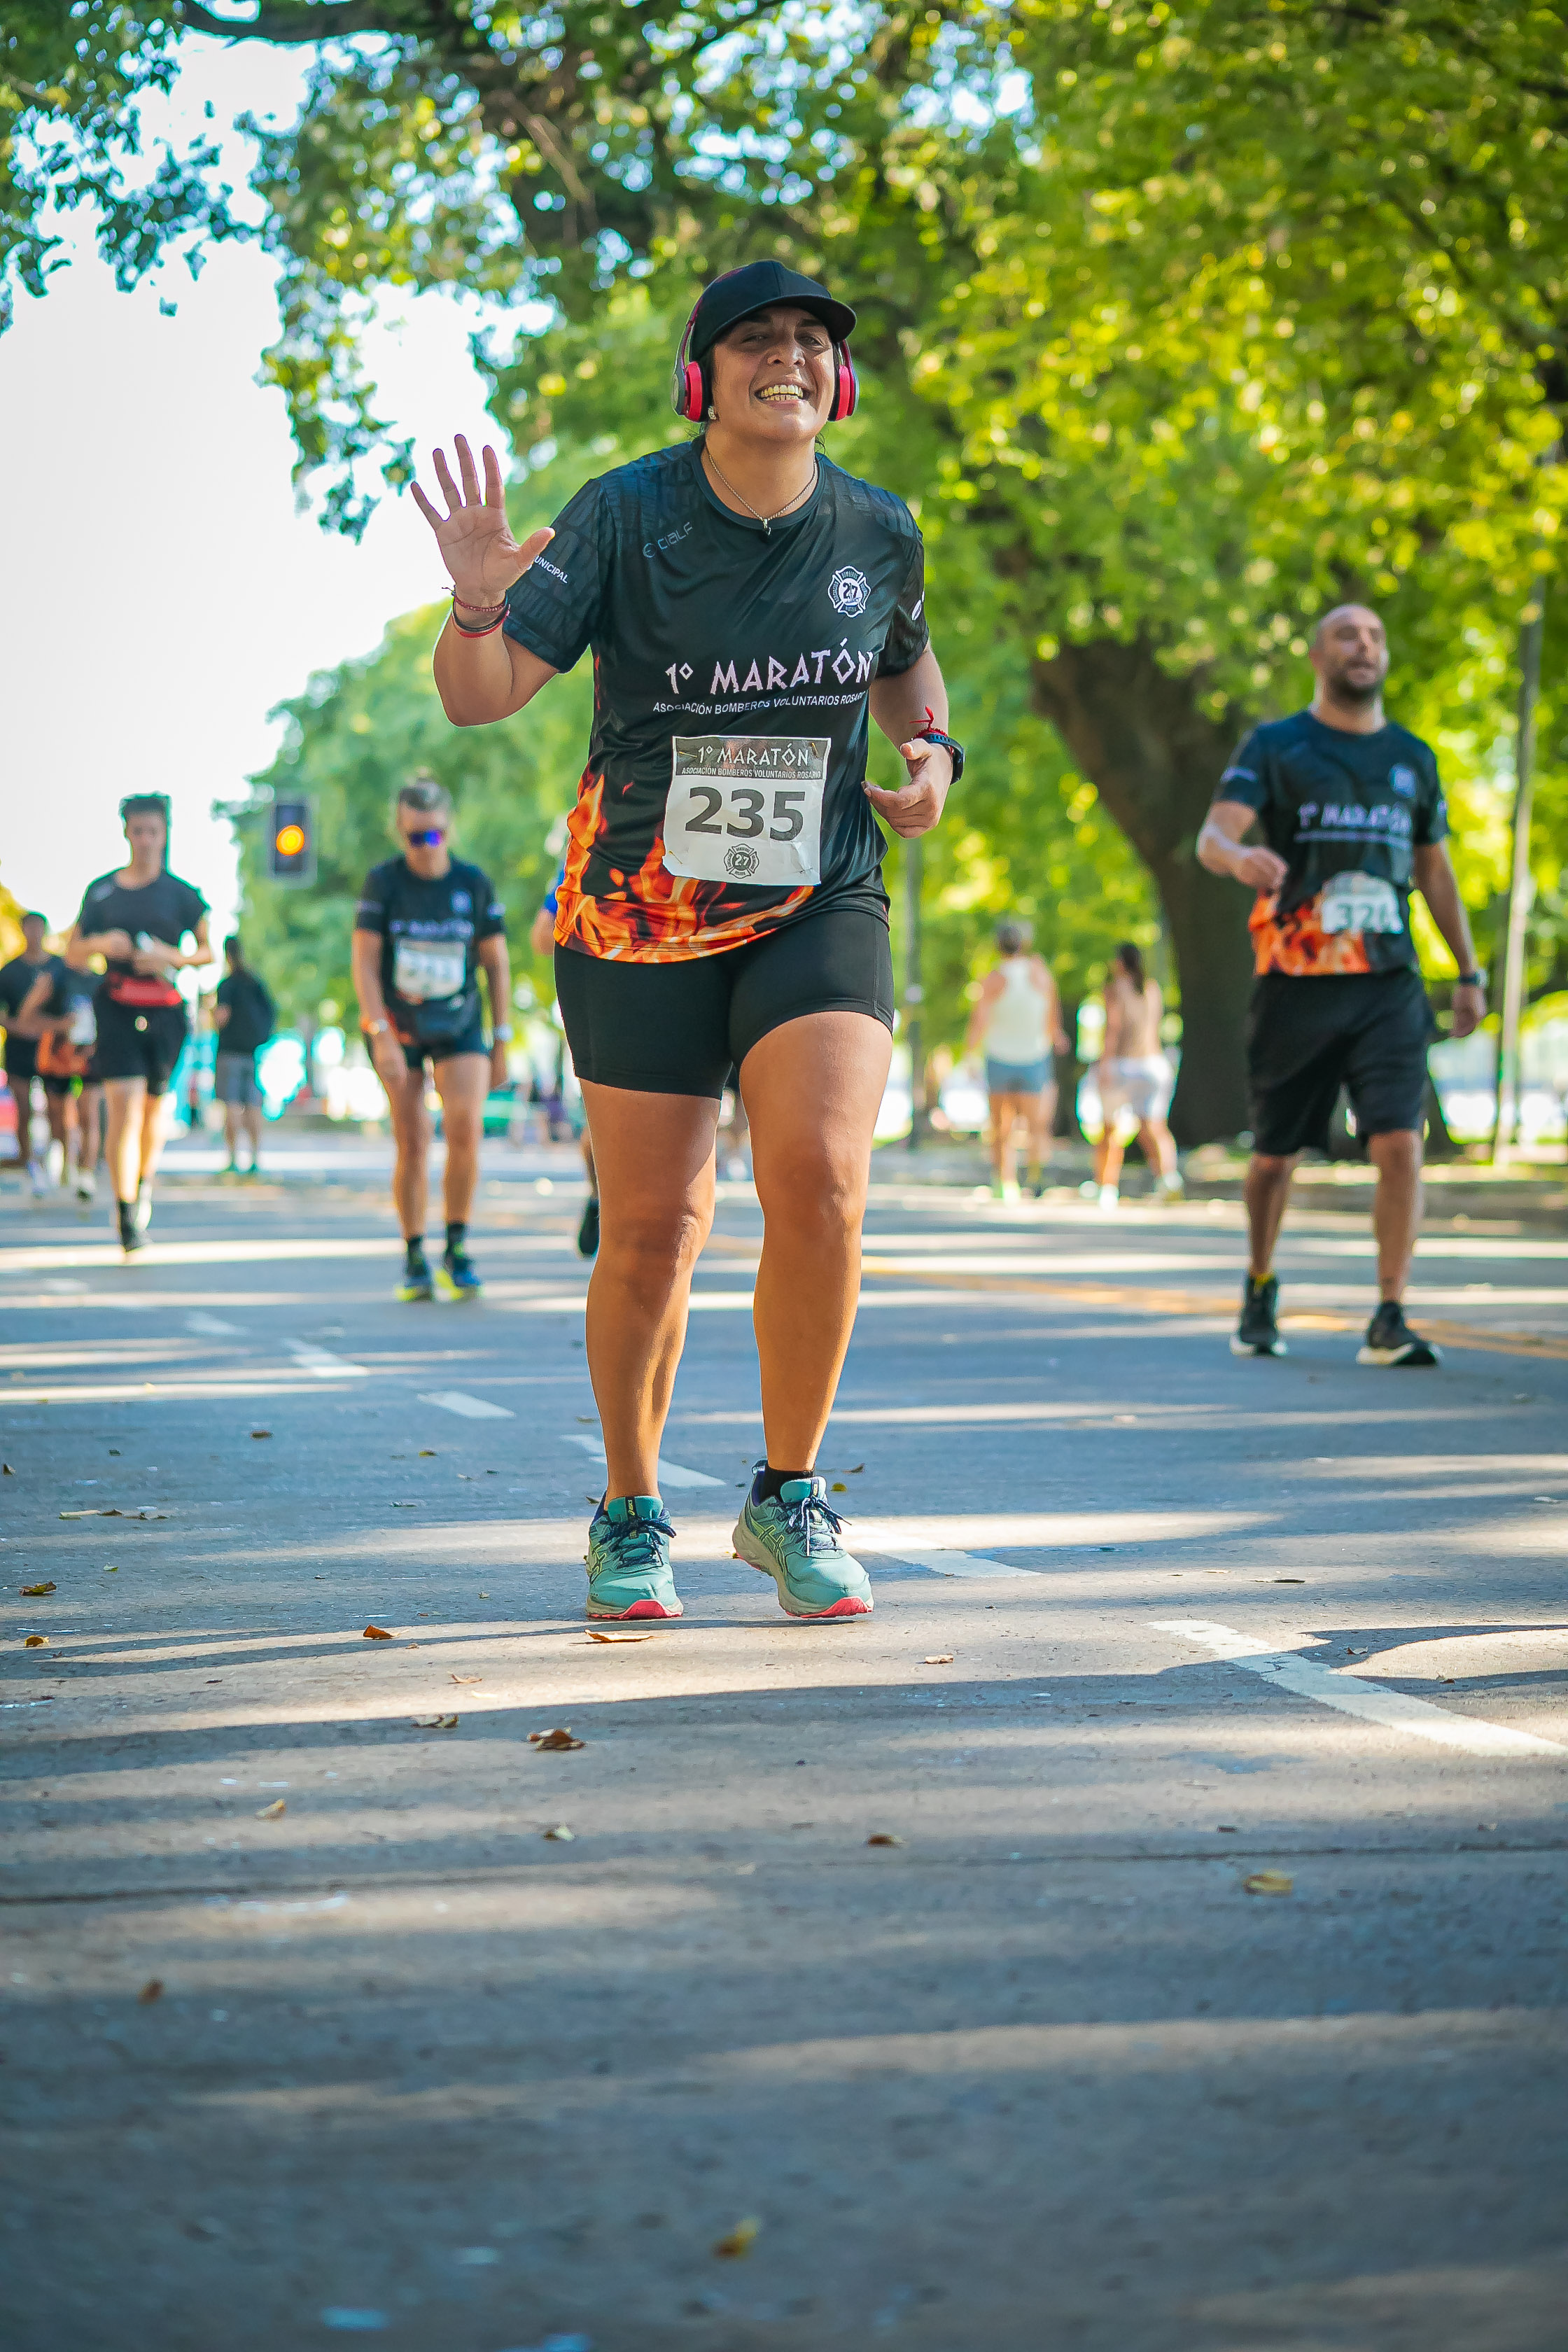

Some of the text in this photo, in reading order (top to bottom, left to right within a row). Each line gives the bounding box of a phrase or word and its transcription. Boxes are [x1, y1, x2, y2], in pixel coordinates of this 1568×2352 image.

[533, 554, 568, 584] UNICIPAL
[842, 582, 858, 599] 27
[710, 637, 873, 695] MARATÓN
[653, 701, 713, 715] ASOCIACIÓN
[715, 699, 771, 715] BOMBEROS
[773, 695, 840, 708] VOLUNTARIOS
[717, 743, 809, 767] MARATÓN
[681, 766, 822, 779] ASOCIACIÓN BOMBEROS VOLUNTARIOS ROSARIO
[685, 786, 806, 841] 235
[734, 853, 750, 866] 27
